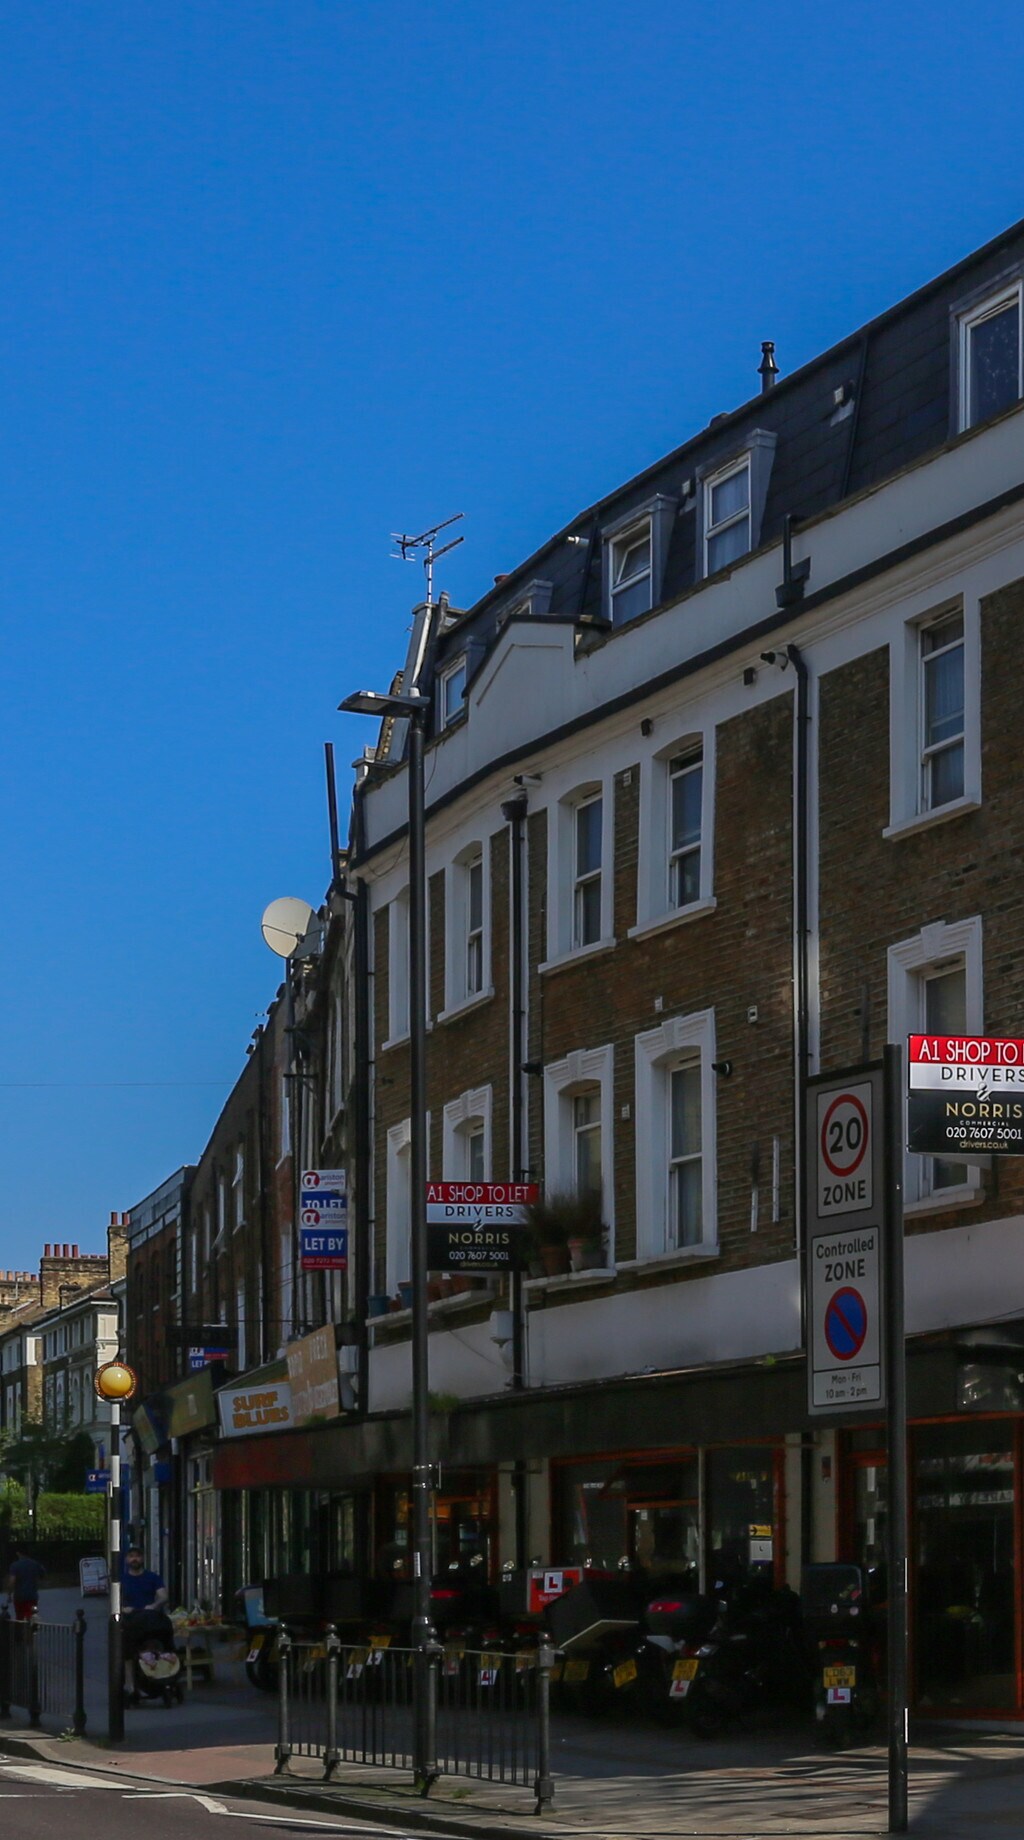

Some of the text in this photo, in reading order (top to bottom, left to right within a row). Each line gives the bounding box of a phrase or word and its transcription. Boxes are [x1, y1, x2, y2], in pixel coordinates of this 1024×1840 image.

[919, 1039, 940, 1061] A1
[945, 1040, 991, 1063] SHOP
[994, 1042, 1018, 1064] TO
[976, 1081, 991, 1102] &
[945, 1102, 1023, 1119] NORRIS
[829, 1117, 861, 1154] 20
[946, 1127, 1023, 1140] 020 7607 5001
[427, 1185, 529, 1202] A1 SHOP TO LET
[823, 1180, 867, 1206] ZONE
[444, 1205, 514, 1217] DRIVERS
[304, 1238, 344, 1251] LET BY
[448, 1232, 510, 1244] NORRIS
[816, 1236, 875, 1260] Controlled
[449, 1250, 510, 1261] 020 7607 5001
[824, 1259, 866, 1283] ZONE
[831, 1374, 847, 1384] Mon
[851, 1372, 862, 1382] Fri
[826, 1388, 834, 1399] 10
[835, 1390, 846, 1398] am
[850, 1386, 855, 1396] 2
[856, 1387, 868, 1397] pm
[549, 1576, 558, 1589] L
[833, 1687, 846, 1701] L
